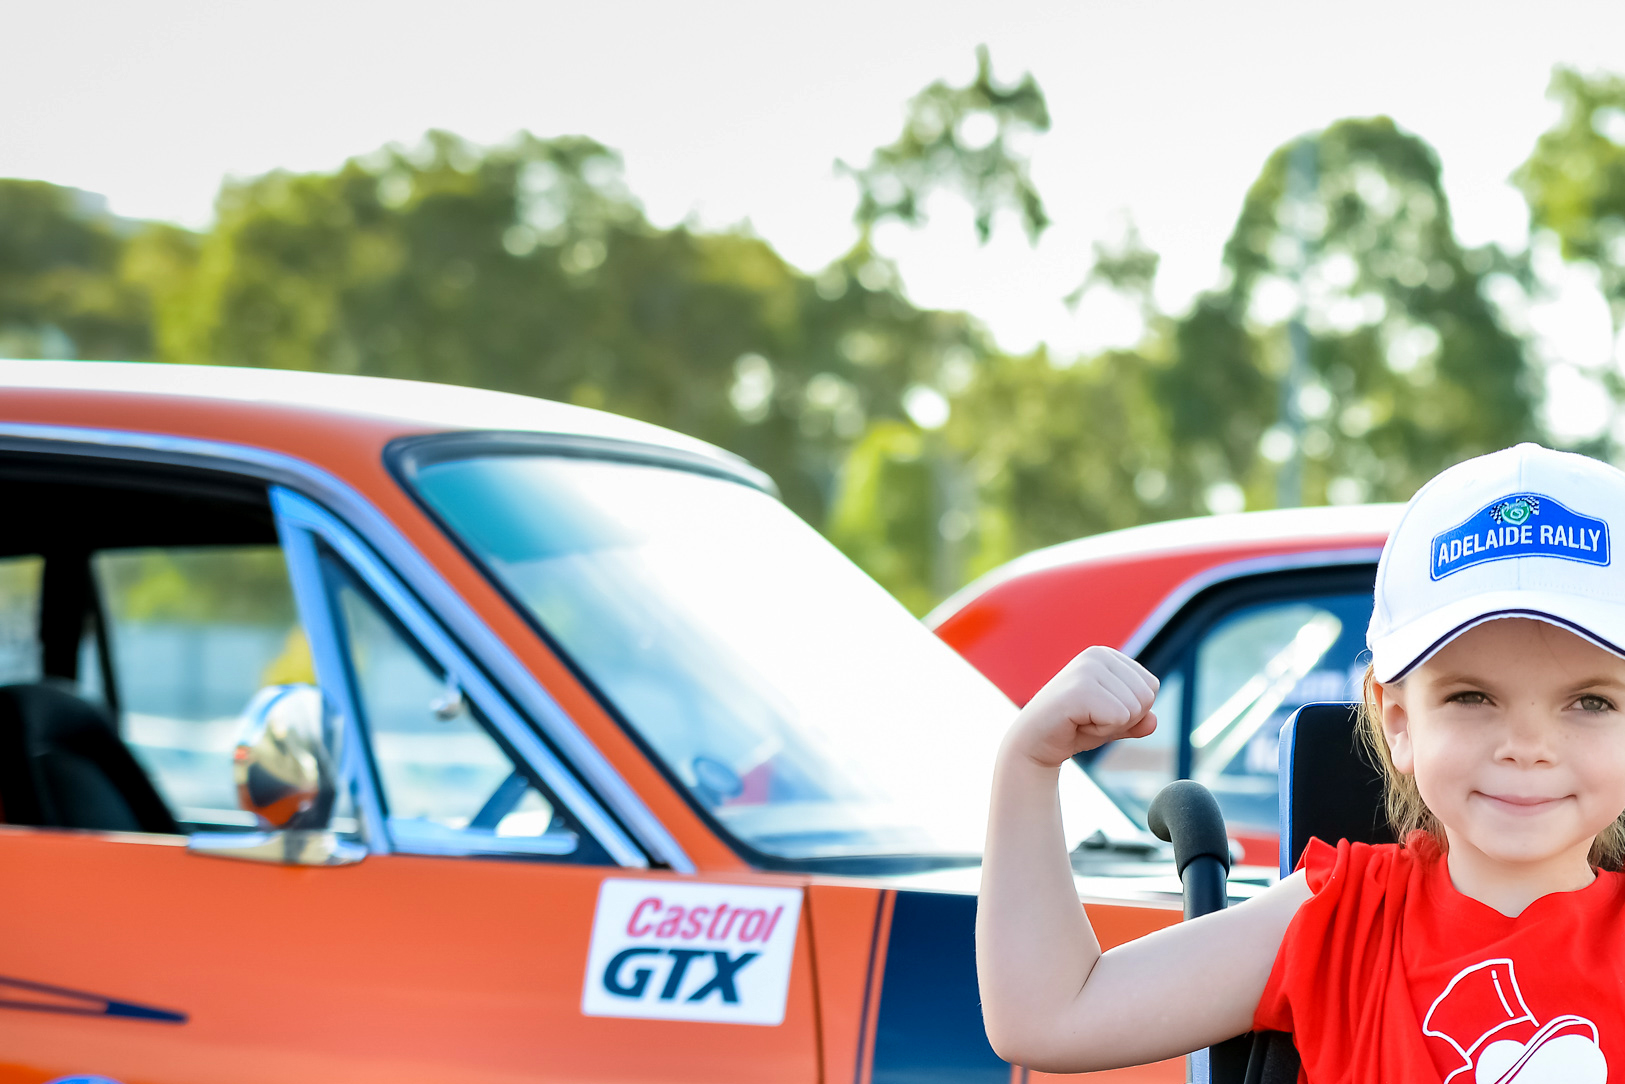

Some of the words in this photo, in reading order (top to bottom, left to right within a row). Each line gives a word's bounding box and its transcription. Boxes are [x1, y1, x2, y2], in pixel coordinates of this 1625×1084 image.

[1437, 526, 1533, 567] ADELAIDE
[1540, 525, 1601, 552] RALLY
[626, 897, 784, 943] Castrol
[602, 948, 763, 1003] GTX
